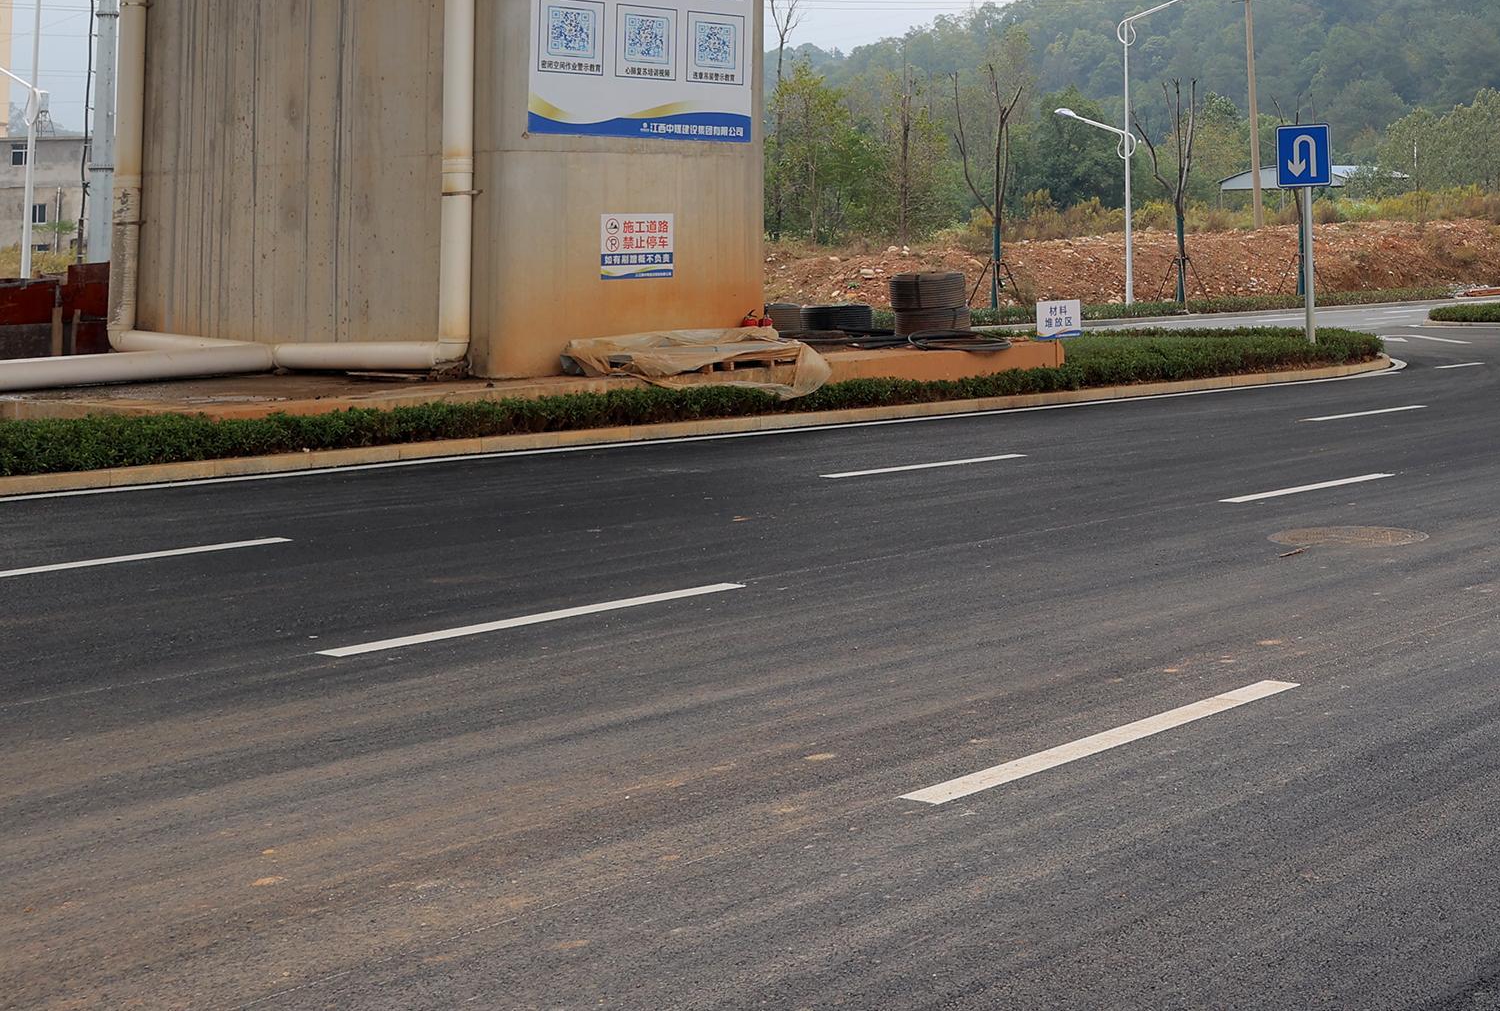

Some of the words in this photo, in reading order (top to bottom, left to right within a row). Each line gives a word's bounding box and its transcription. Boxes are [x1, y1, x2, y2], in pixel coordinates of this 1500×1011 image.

[650, 122, 744, 137] 江西中煤建设集团有限公司
[623, 220, 669, 234] 施工道路
[623, 236, 669, 249] 禁止停车
[1049, 305, 1067, 316] 材料
[1045, 317, 1073, 328] 堆放区
